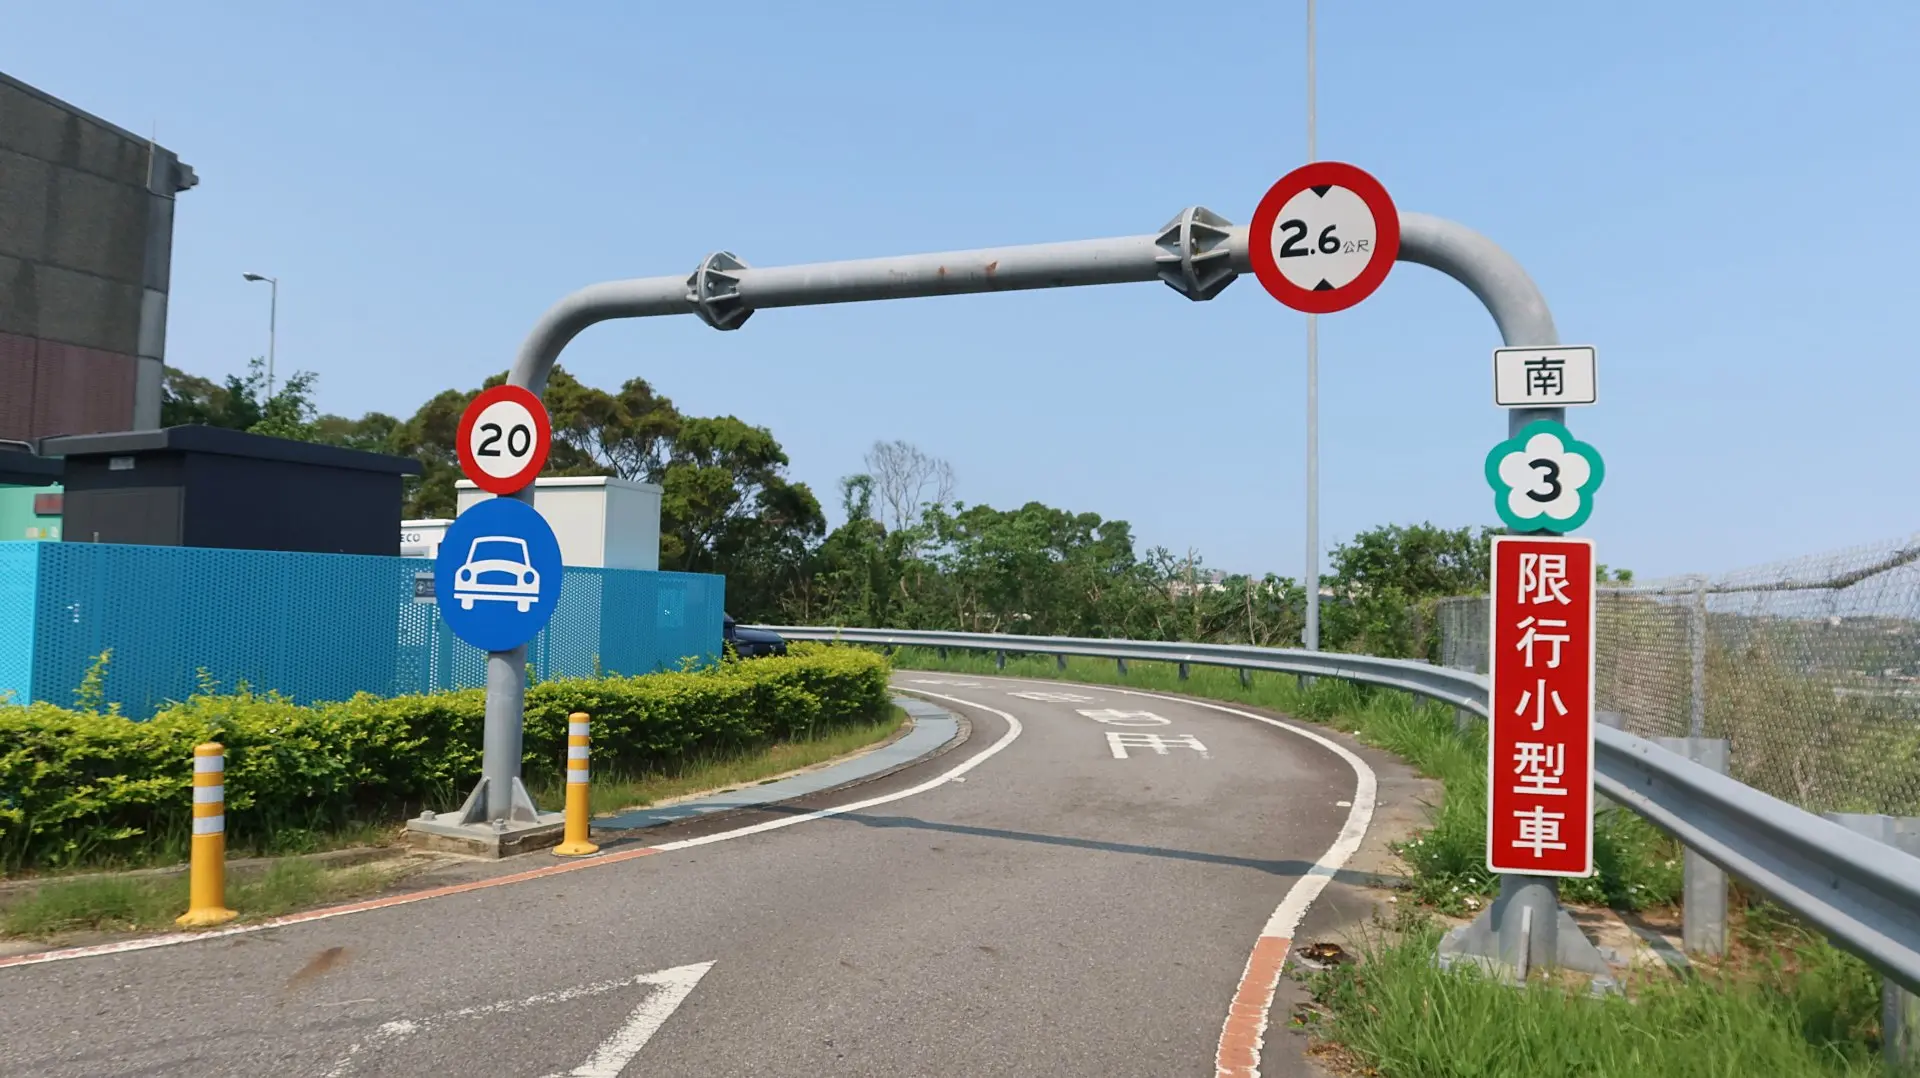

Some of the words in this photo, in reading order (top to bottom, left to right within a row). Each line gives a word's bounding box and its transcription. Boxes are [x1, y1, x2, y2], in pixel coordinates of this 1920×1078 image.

[1524, 356, 1566, 396] 南
[477, 423, 531, 458] 20
[1525, 458, 1562, 503] 3
[1511, 553, 1572, 858] 限行小型車
